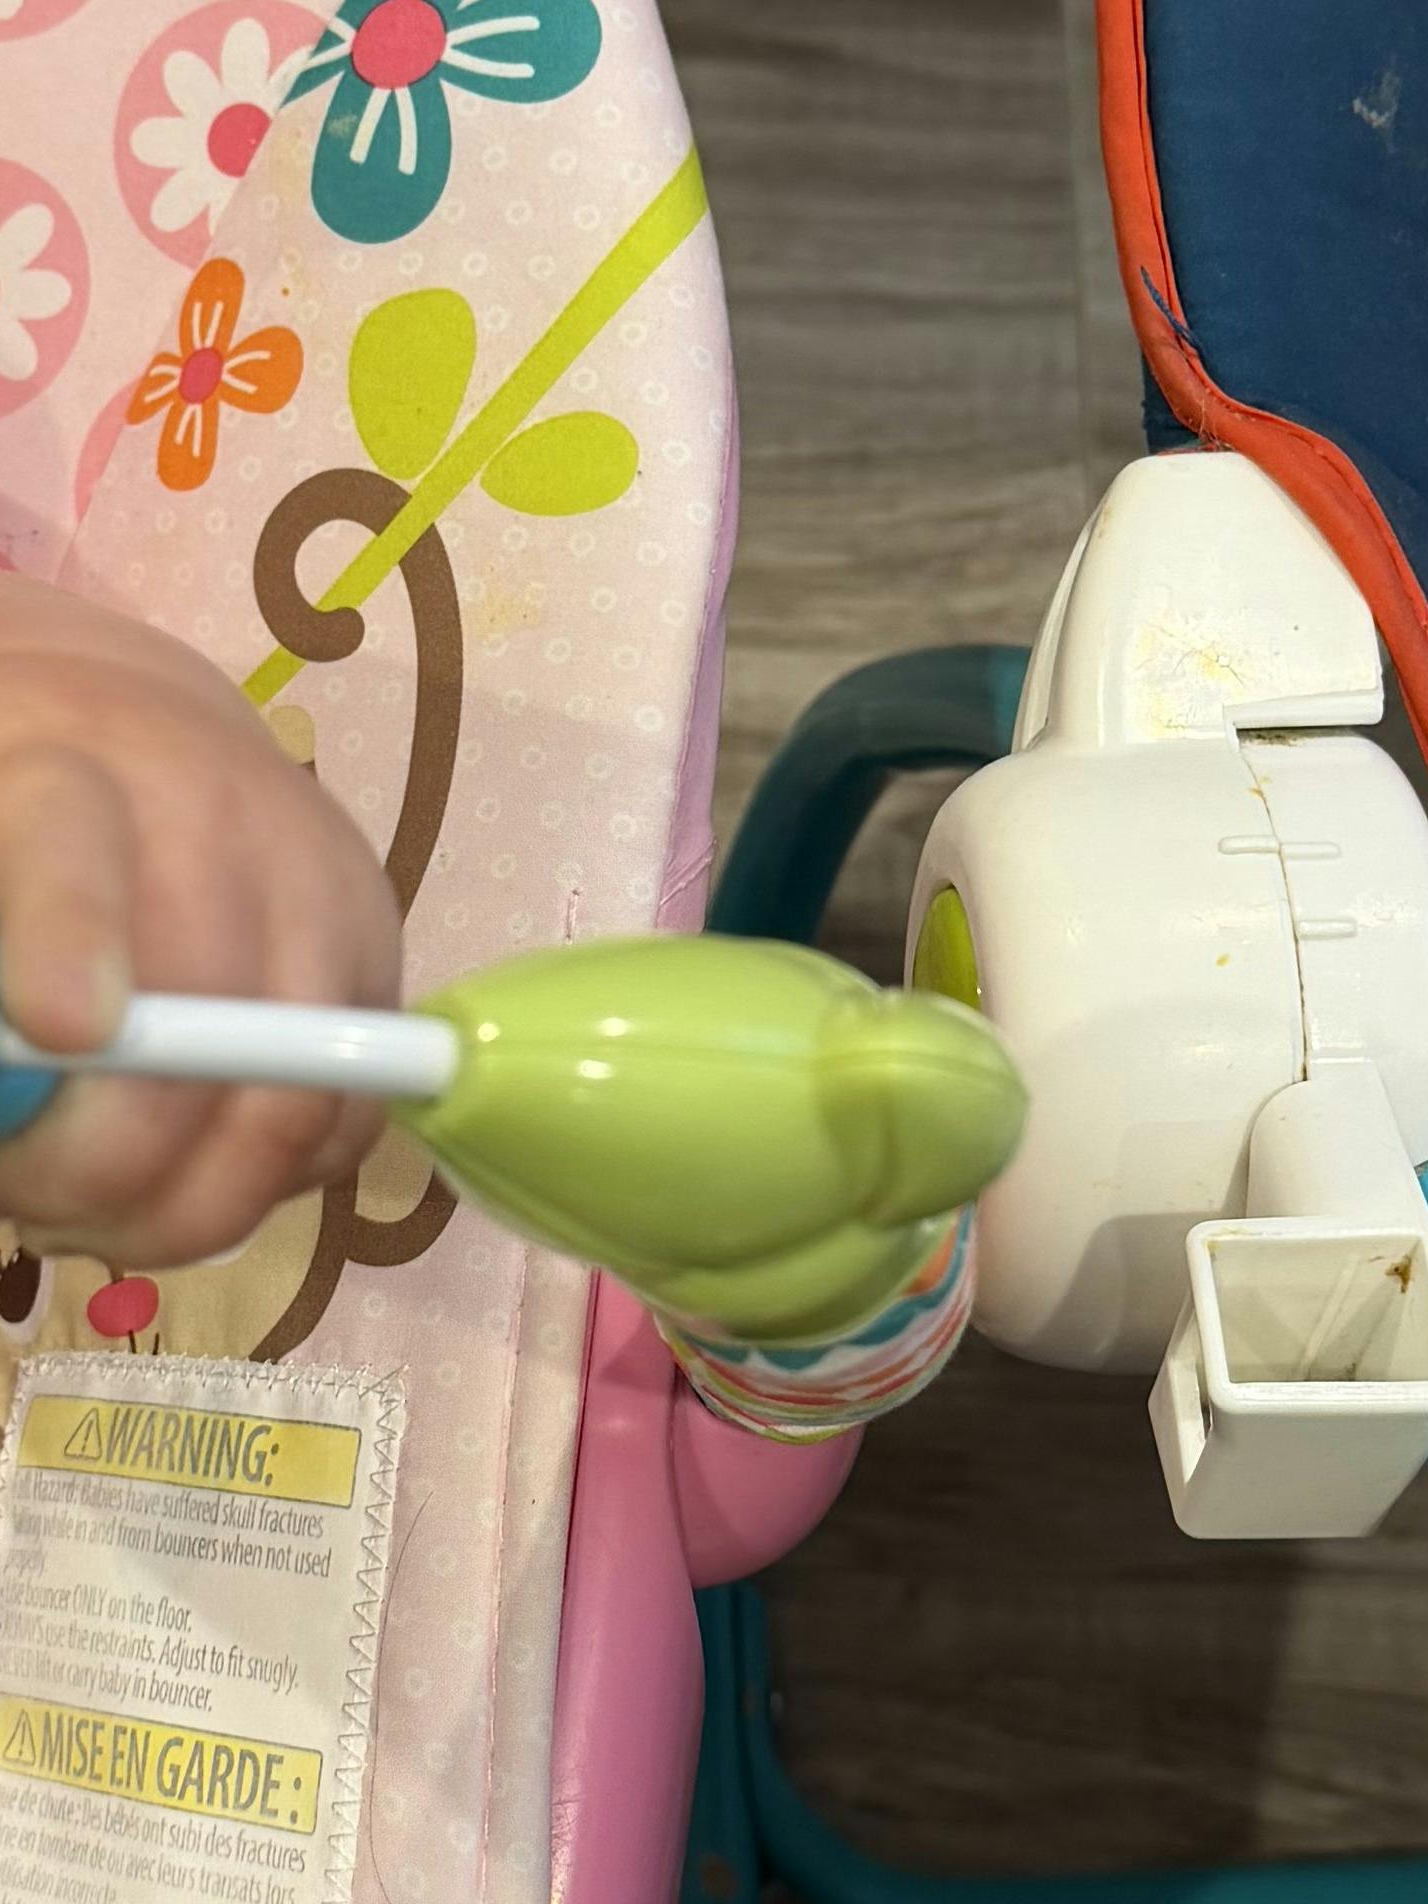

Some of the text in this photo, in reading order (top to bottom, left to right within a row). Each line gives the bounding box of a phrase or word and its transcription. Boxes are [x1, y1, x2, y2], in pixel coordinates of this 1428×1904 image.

[106, 1407, 280, 1487] WARNING:
[33, 1472, 79, 1504] Hazard:
[82, 1475, 123, 1512] Babies
[126, 1480, 161, 1517] have
[162, 1489, 221, 1524] suffered
[222, 1495, 257, 1531] skull
[258, 1502, 324, 1540] fractures
[90, 1516, 117, 1546] and
[118, 1518, 152, 1552] from
[153, 1522, 219, 1562] bouncers
[222, 1534, 264, 1569] when
[265, 1546, 292, 1572] not
[294, 1547, 332, 1578] used
[25, 1579, 72, 1611] bouncer
[72, 1584, 108, 1617] ONLY
[108, 1596, 127, 1621] on
[129, 1592, 155, 1626] the
[156, 1595, 192, 1633] floor.
[46, 1623, 66, 1648] use
[68, 1619, 89, 1650] the
[90, 1627, 156, 1664] restraints.
[158, 1635, 208, 1677] Adjust
[210, 1646, 224, 1675] to
[227, 1645, 244, 1678] fit
[246, 1653, 299, 1696] snugly.
[52, 1661, 66, 1684] or
[67, 1662, 98, 1697] carry
[98, 1663, 131, 1702] baby
[133, 1667, 147, 1698] in
[149, 1669, 213, 1712] bouncer.
[39, 1711, 105, 1783] MISE
[109, 1724, 153, 1792] EN
[156, 1736, 285, 1818] GARDE
[18, 1783, 38, 1815] de
[82, 1798, 102, 1831] Des
[142, 1817, 166, 1846] ont
[167, 1818, 204, 1854] subi
[205, 1824, 233, 1859] des
[236, 1829, 307, 1874] fractures
[18, 1827, 37, 1854] en
[37, 1828, 90, 1868] tombant
[90, 1839, 107, 1871] de
[107, 1850, 125, 1876] ou
[126, 1853, 157, 1884] avec
[156, 1852, 196, 1891] leurs
[199, 1866, 262, 1904] transats
